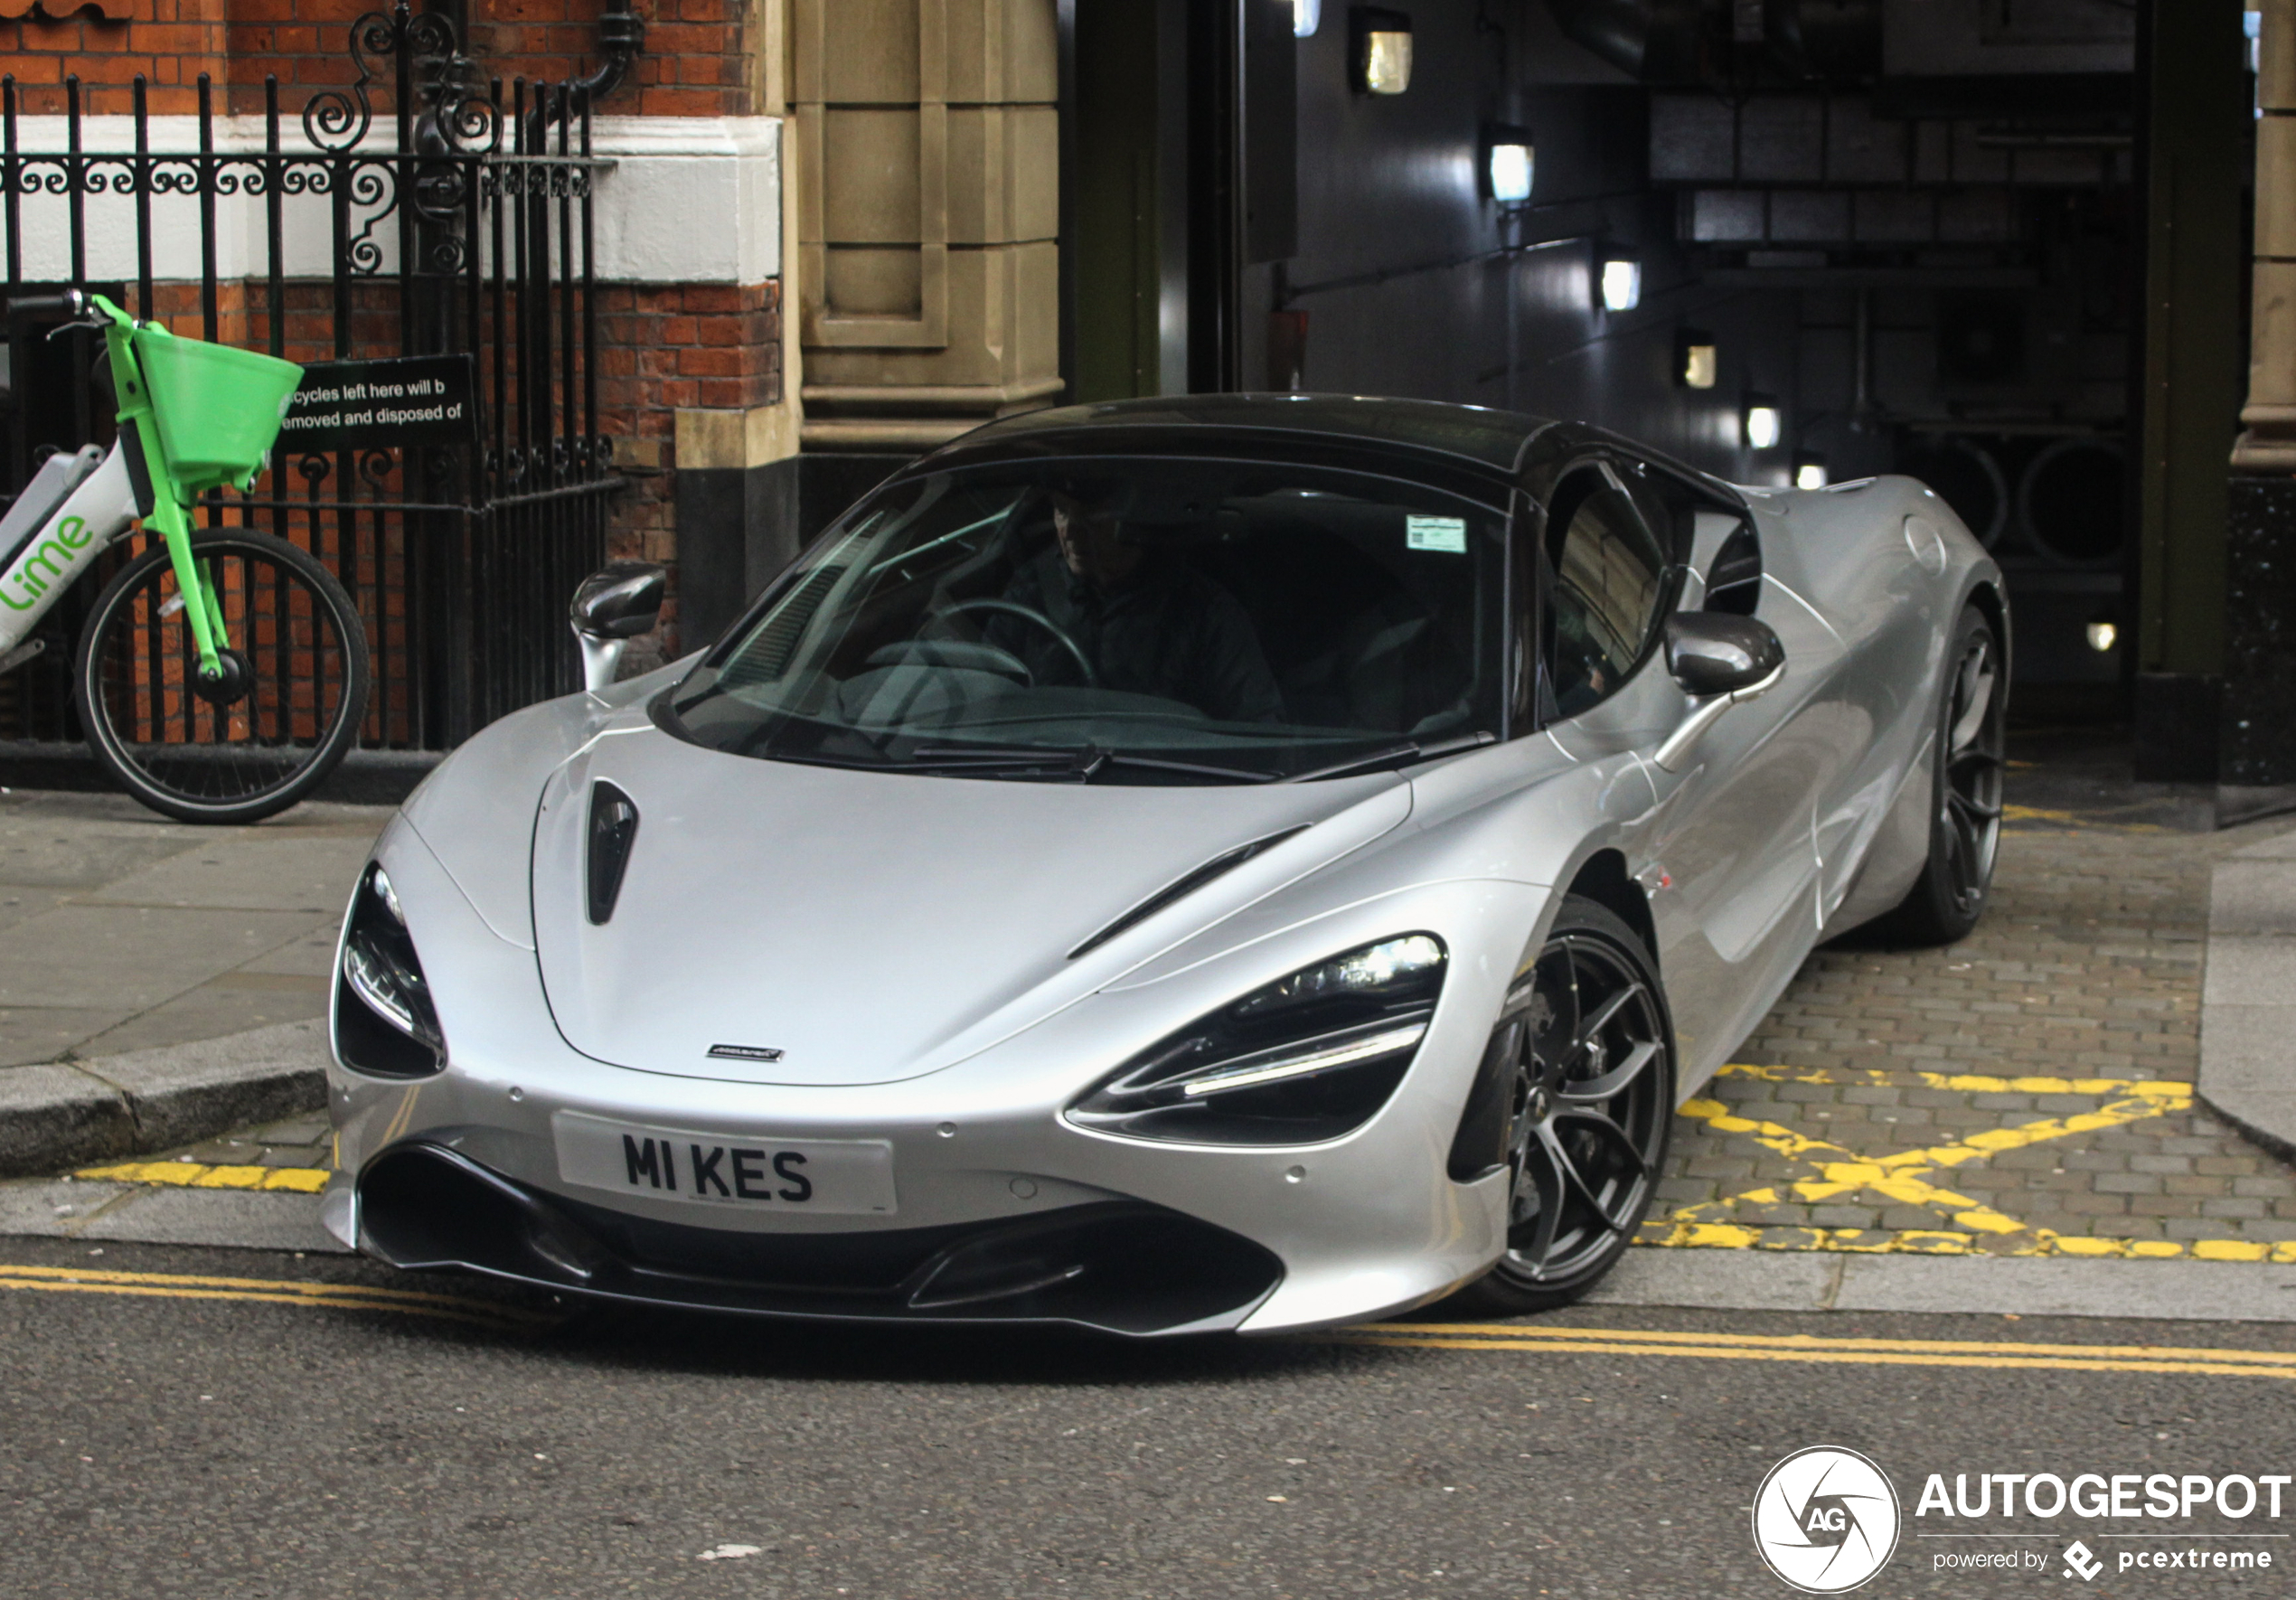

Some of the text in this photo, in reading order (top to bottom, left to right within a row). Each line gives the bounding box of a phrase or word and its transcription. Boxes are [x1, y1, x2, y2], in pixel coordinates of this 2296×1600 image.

[343, 383, 366, 400] left
[370, 381, 403, 398] here
[408, 378, 431, 396] will
[435, 378, 446, 395] b
[281, 401, 462, 430] emoved and disposed of
[690, 1143, 814, 1203] KES
